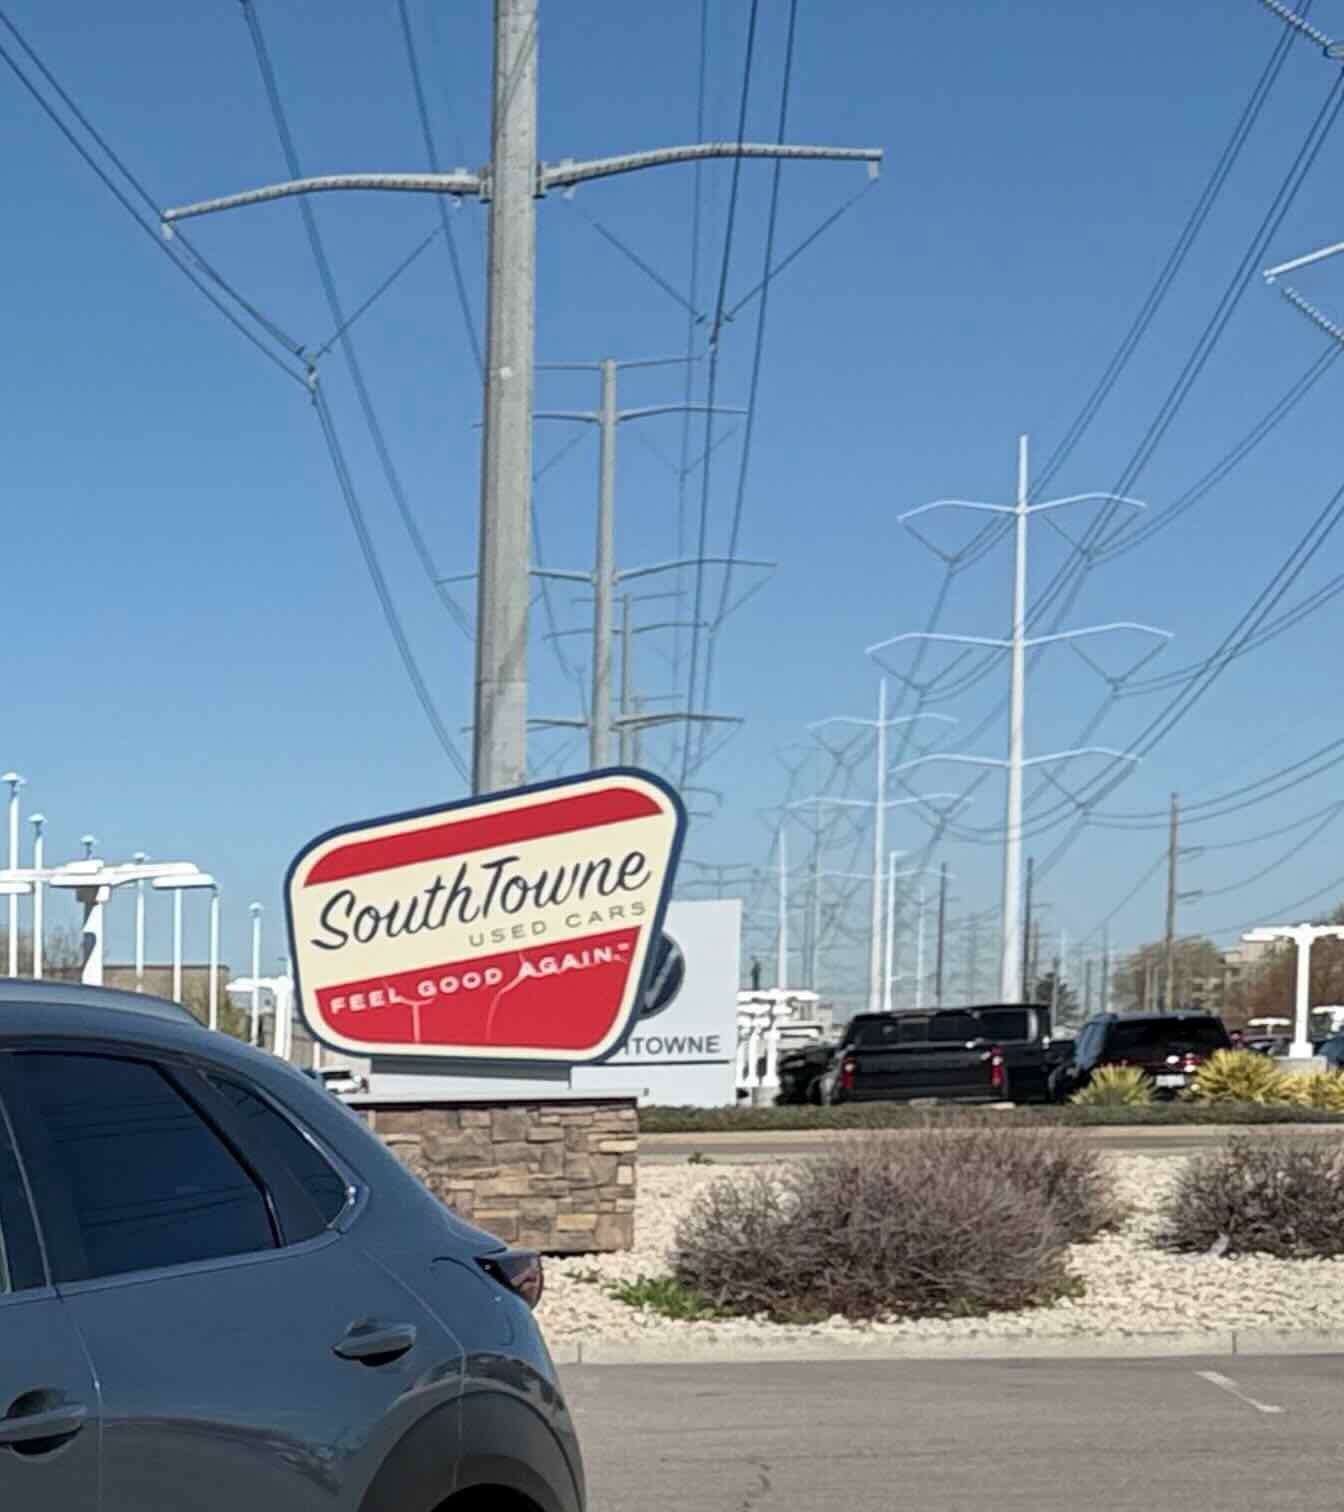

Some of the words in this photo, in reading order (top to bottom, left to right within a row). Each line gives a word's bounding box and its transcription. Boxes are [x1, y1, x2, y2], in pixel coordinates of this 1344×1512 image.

[311, 850, 652, 950] SouthTowne
[469, 920, 547, 947] USED
[565, 901, 646, 930] CARS
[330, 987, 399, 1014] FEEL
[417, 967, 503, 997] GOOD
